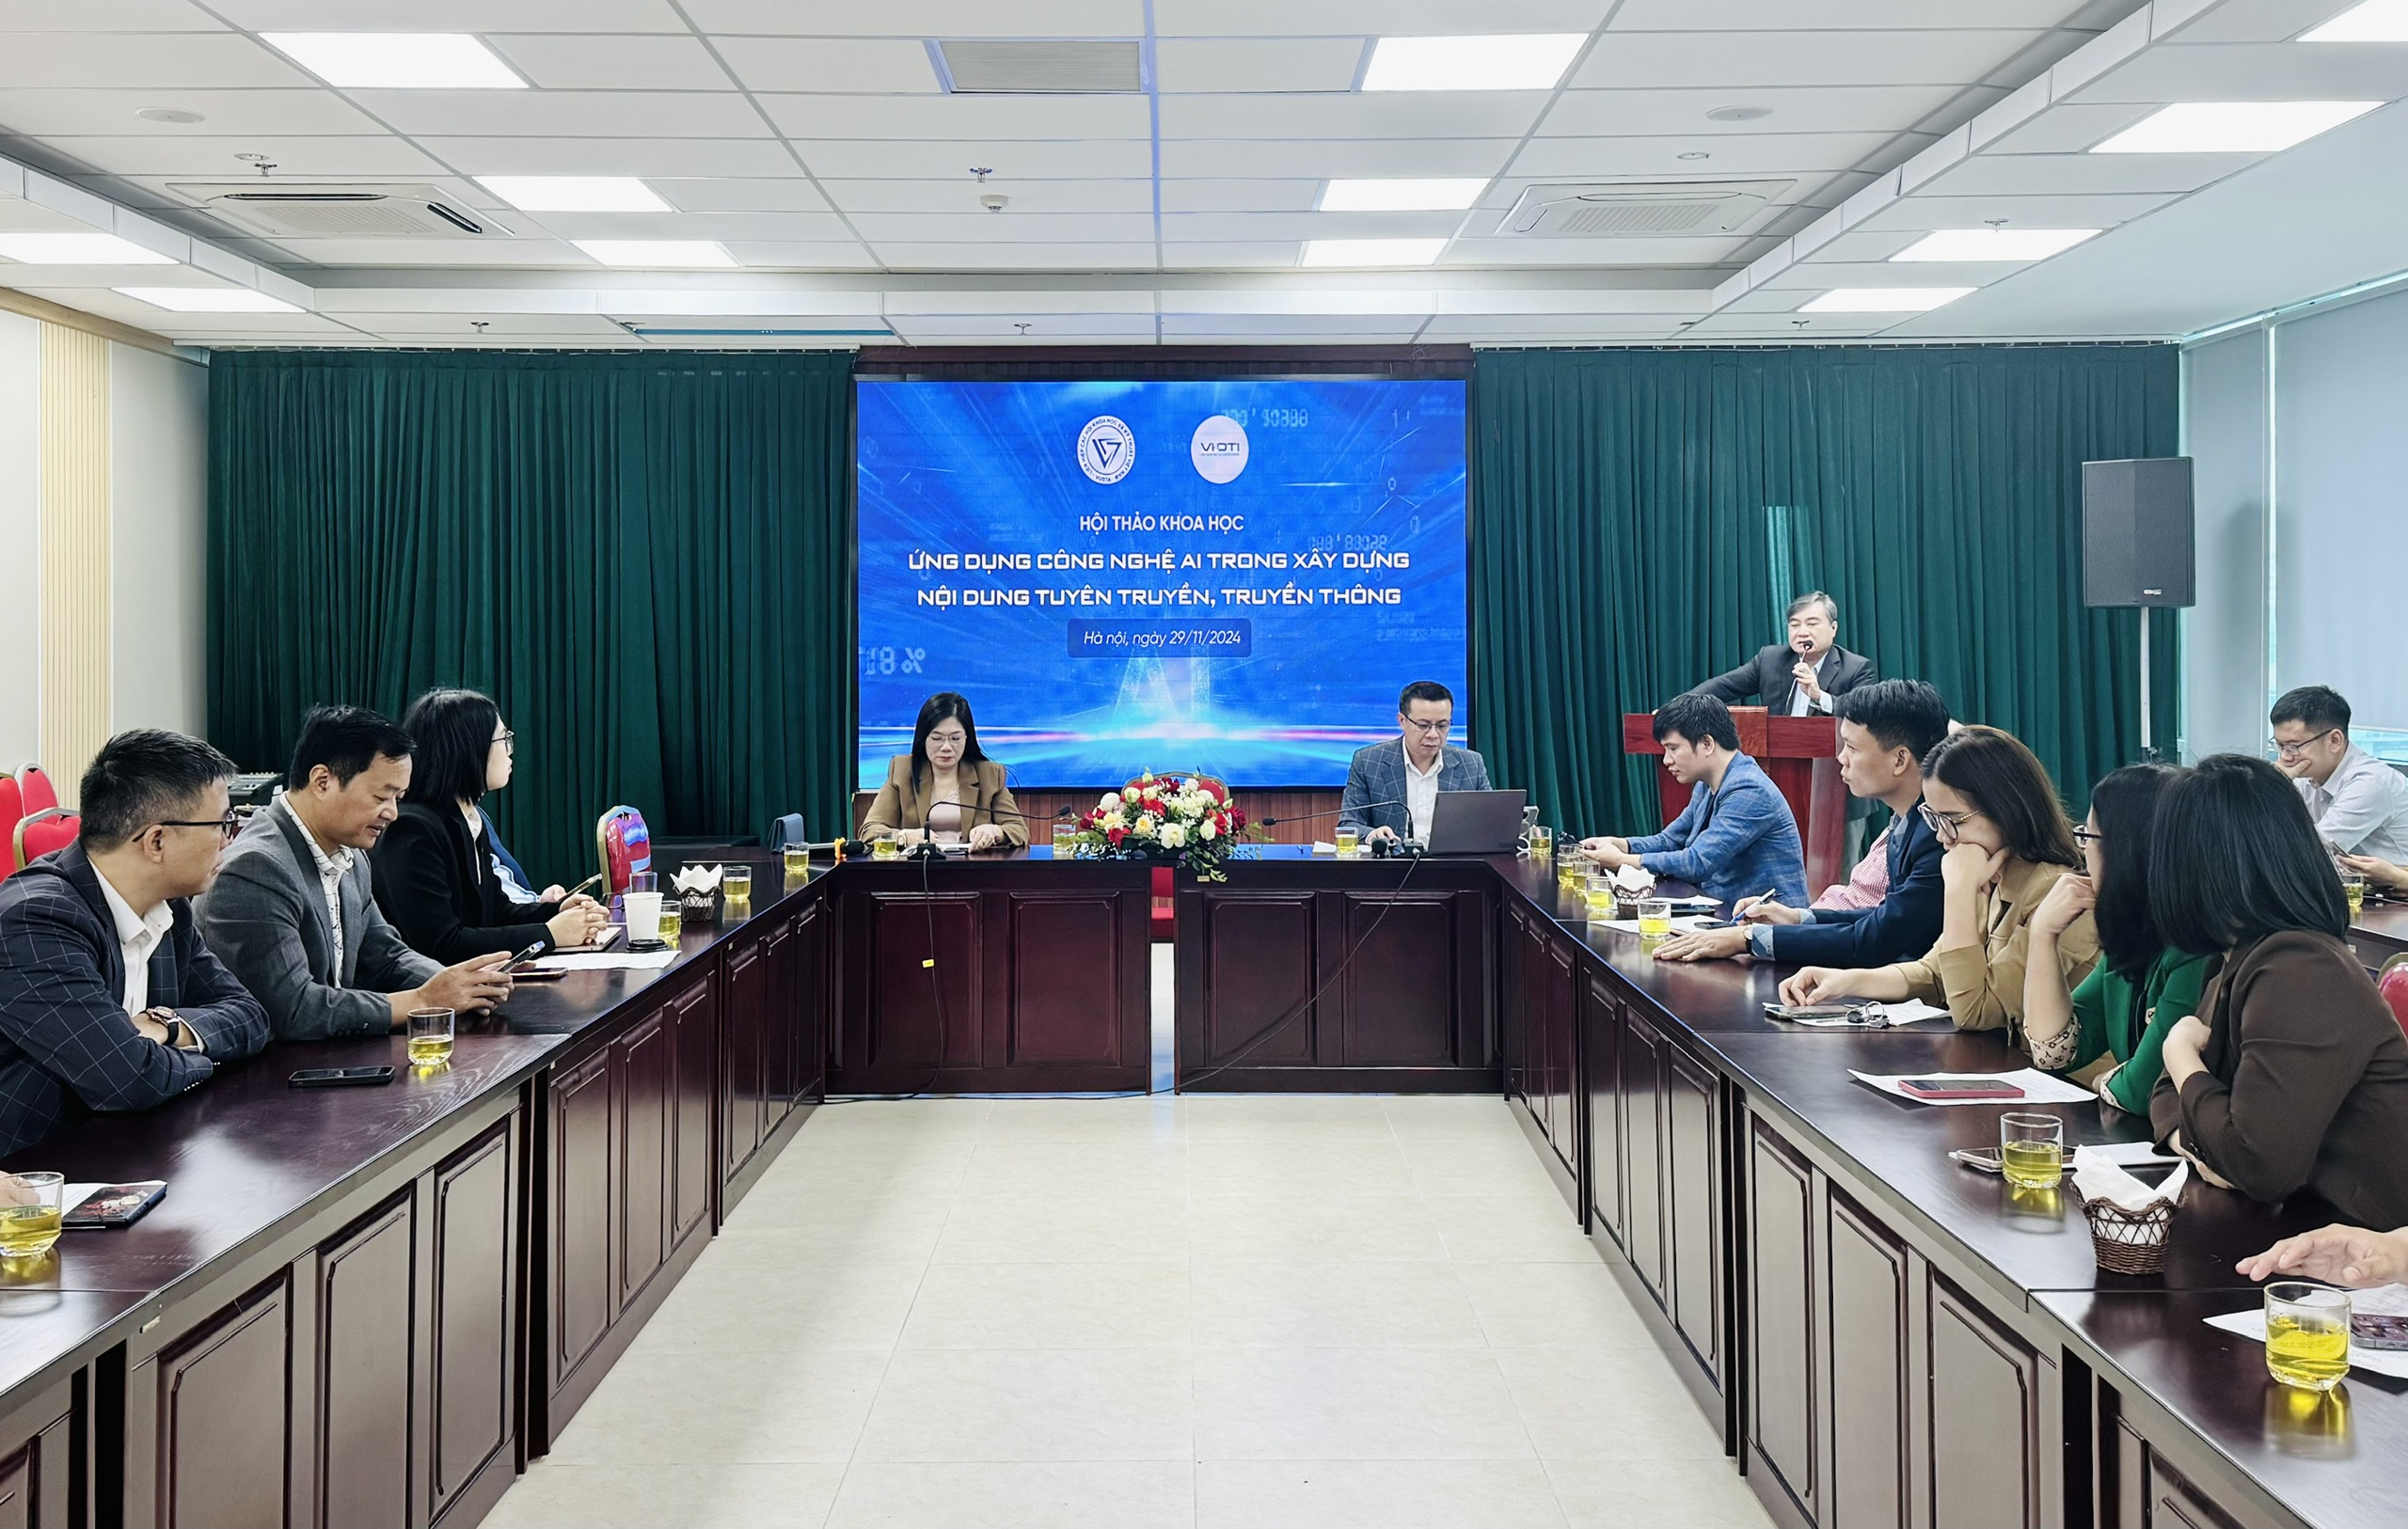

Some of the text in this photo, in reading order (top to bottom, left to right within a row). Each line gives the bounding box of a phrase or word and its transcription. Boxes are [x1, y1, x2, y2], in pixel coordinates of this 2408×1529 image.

[1079, 511, 1244, 535] HỘI THẢO KHOA HỌC
[909, 547, 1410, 575] ỨNG DỤNG CÔNG NGHỆ AI TRONG XÂY DỰNG
[917, 581, 1402, 611] NỘI DUNG TUYÊN TRUYỀN, TRUYỀN THÔNG
[1084, 629, 1242, 648] Hà nội, ngày 29/11/2024
